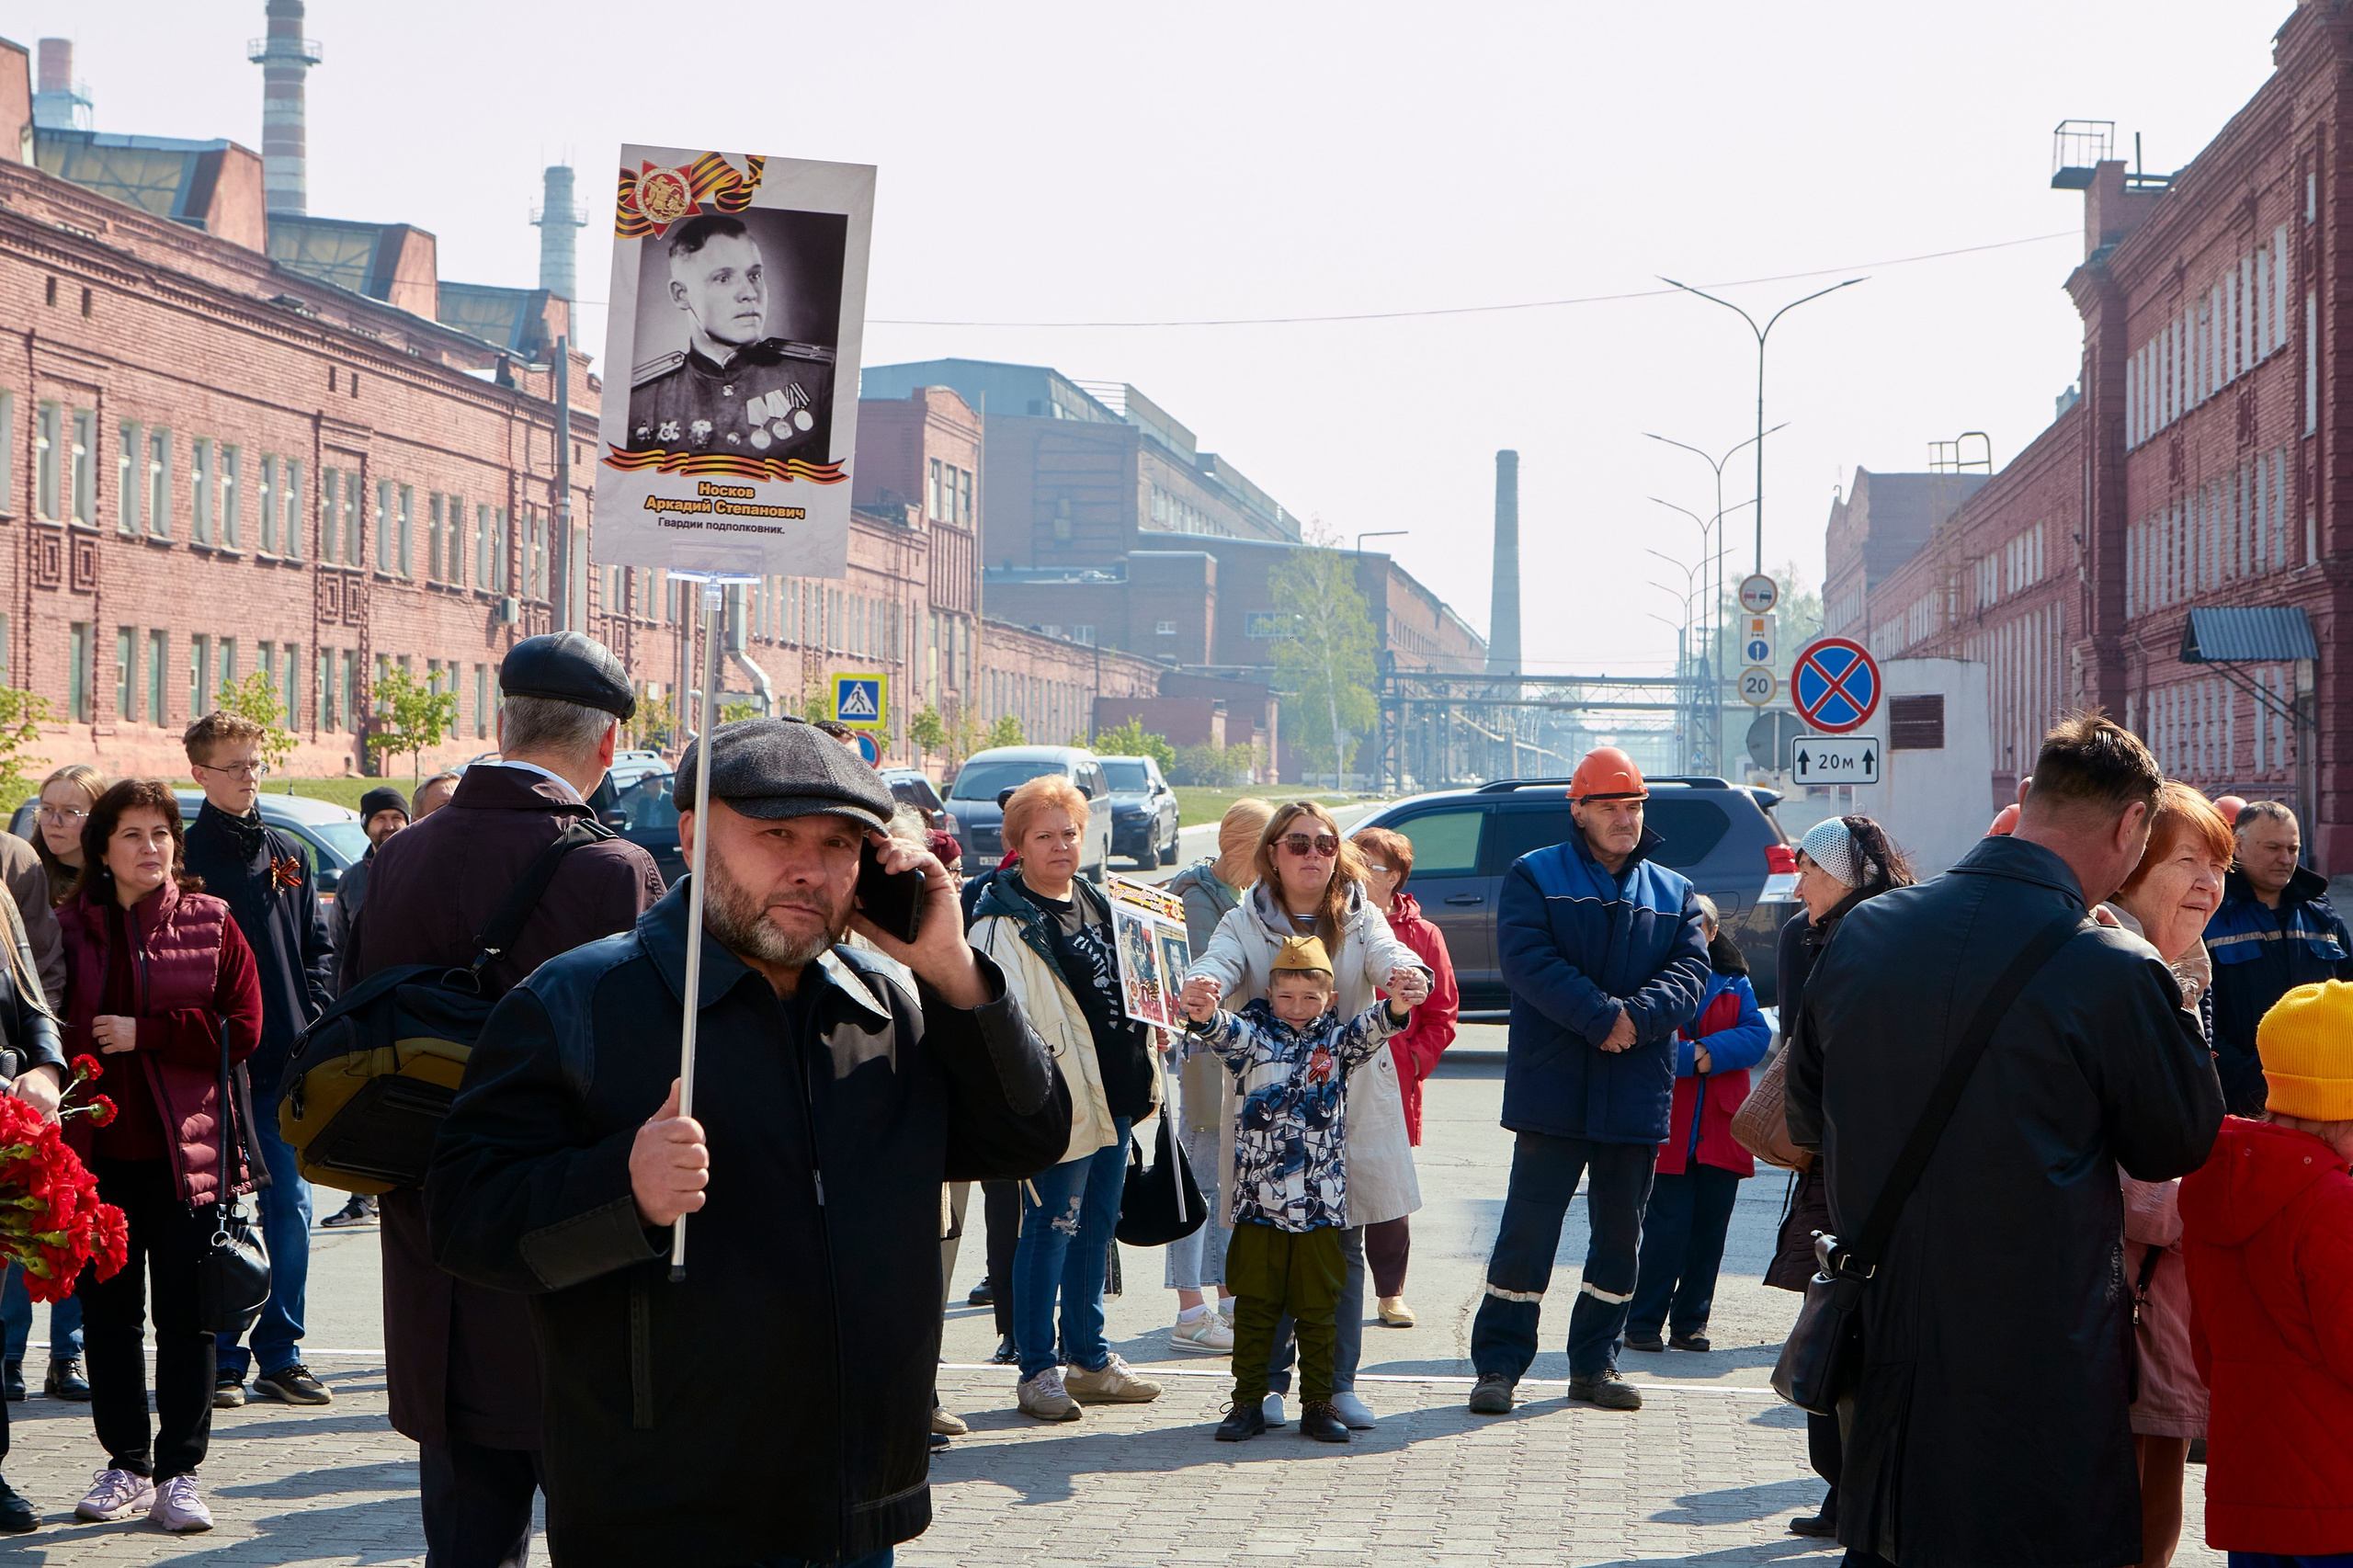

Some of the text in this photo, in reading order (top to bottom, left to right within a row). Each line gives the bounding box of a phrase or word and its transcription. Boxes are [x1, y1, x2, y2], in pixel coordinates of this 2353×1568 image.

[699, 482, 756, 499] Носков
[644, 495, 805, 519] Аркадий Степанович
[658, 517, 786, 534] Гвардии подполковник.
[1745, 677, 1768, 694] 20
